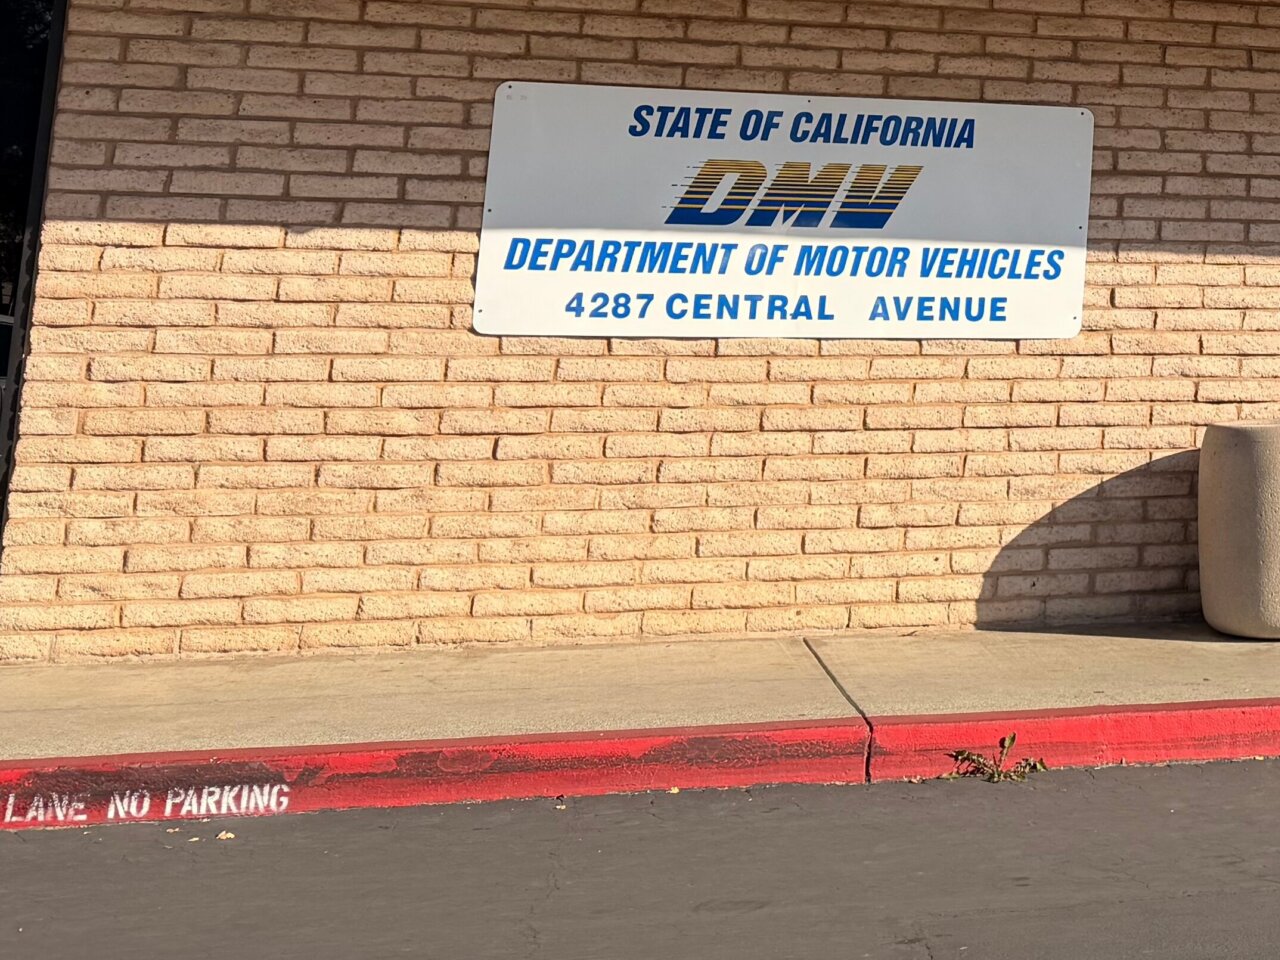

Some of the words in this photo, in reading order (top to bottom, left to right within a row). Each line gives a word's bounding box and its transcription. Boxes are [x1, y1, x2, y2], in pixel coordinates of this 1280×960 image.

[628, 104, 731, 141] STATE
[739, 109, 784, 141] OF
[789, 111, 976, 149] CALIFORNIA
[664, 159, 924, 230] DMV
[503, 237, 738, 276] DEPARTMENT
[744, 243, 787, 276] OF
[793, 244, 909, 278] MOTOR
[919, 246, 1066, 281] VEHICLES
[565, 292, 655, 320] 4287
[665, 292, 835, 321] CENTRAL
[869, 296, 1008, 323] AVENUE
[4, 792, 88, 822] LANE
[107, 789, 151, 819] NO
[164, 783, 290, 817] PARKING
